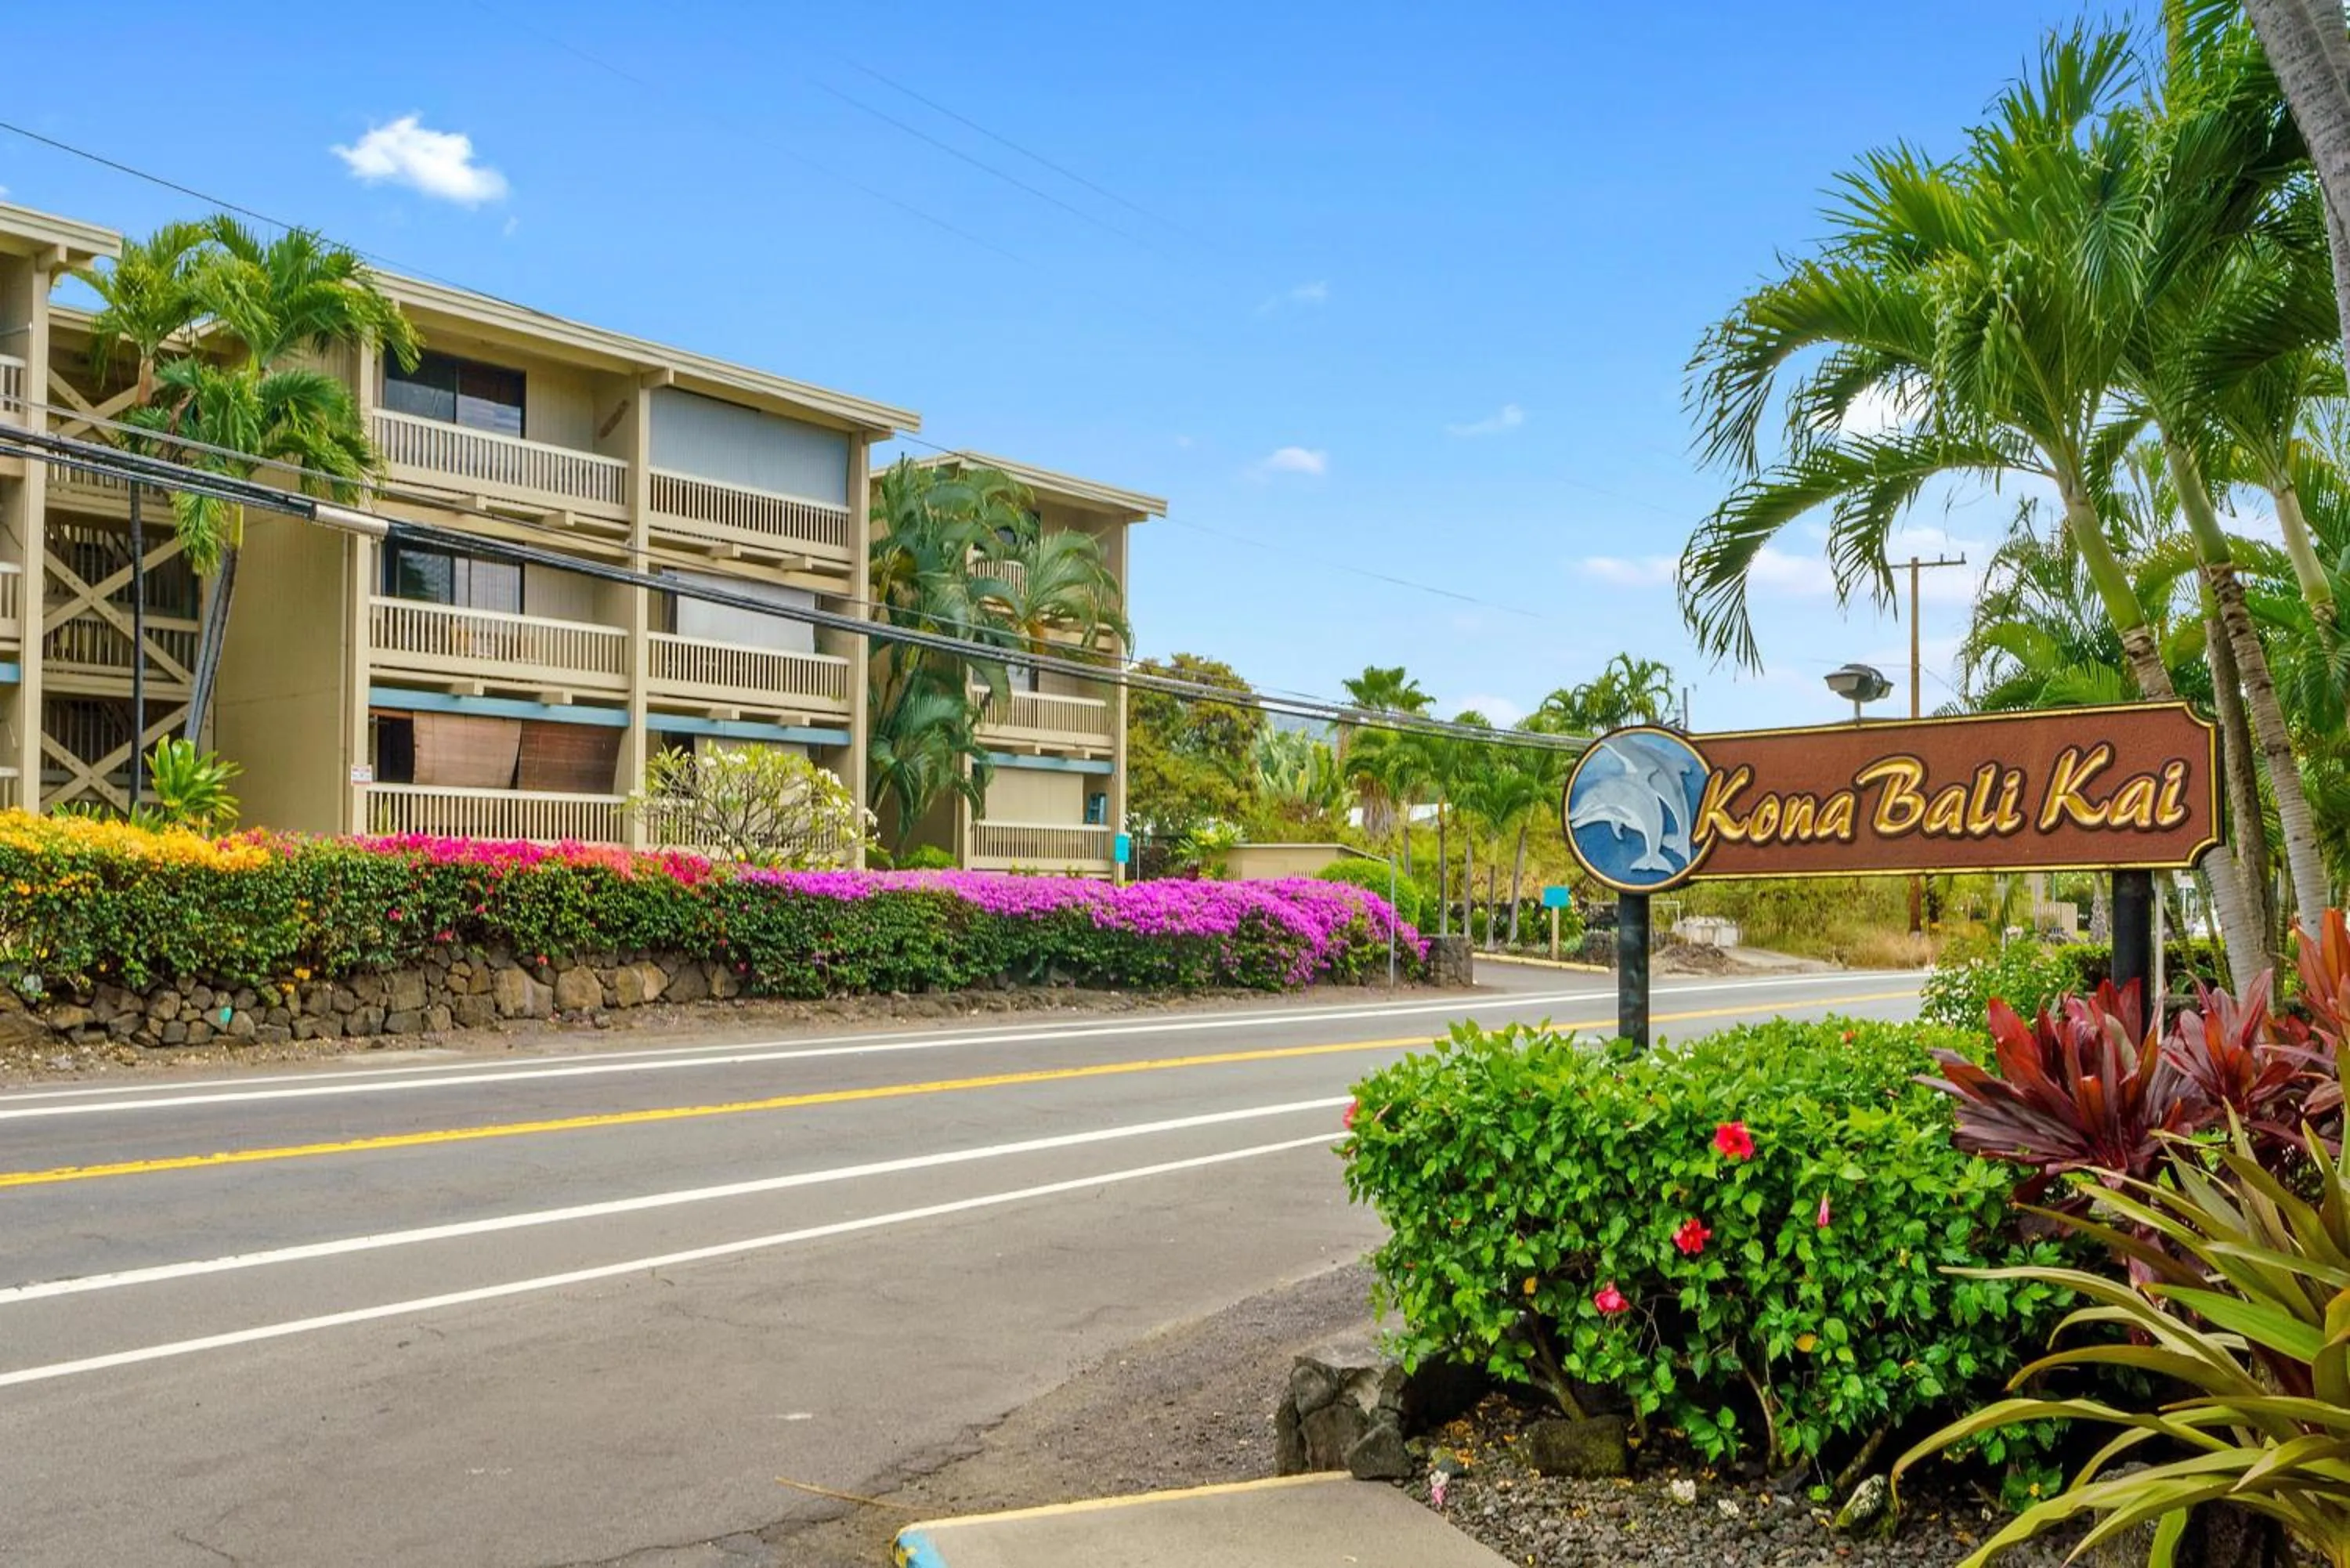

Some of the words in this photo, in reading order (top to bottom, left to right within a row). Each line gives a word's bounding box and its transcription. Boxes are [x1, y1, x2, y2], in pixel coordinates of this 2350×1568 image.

[1692, 765, 1856, 843] Kona
[1855, 754, 2023, 835] Bali
[2038, 744, 2186, 830] Kai
